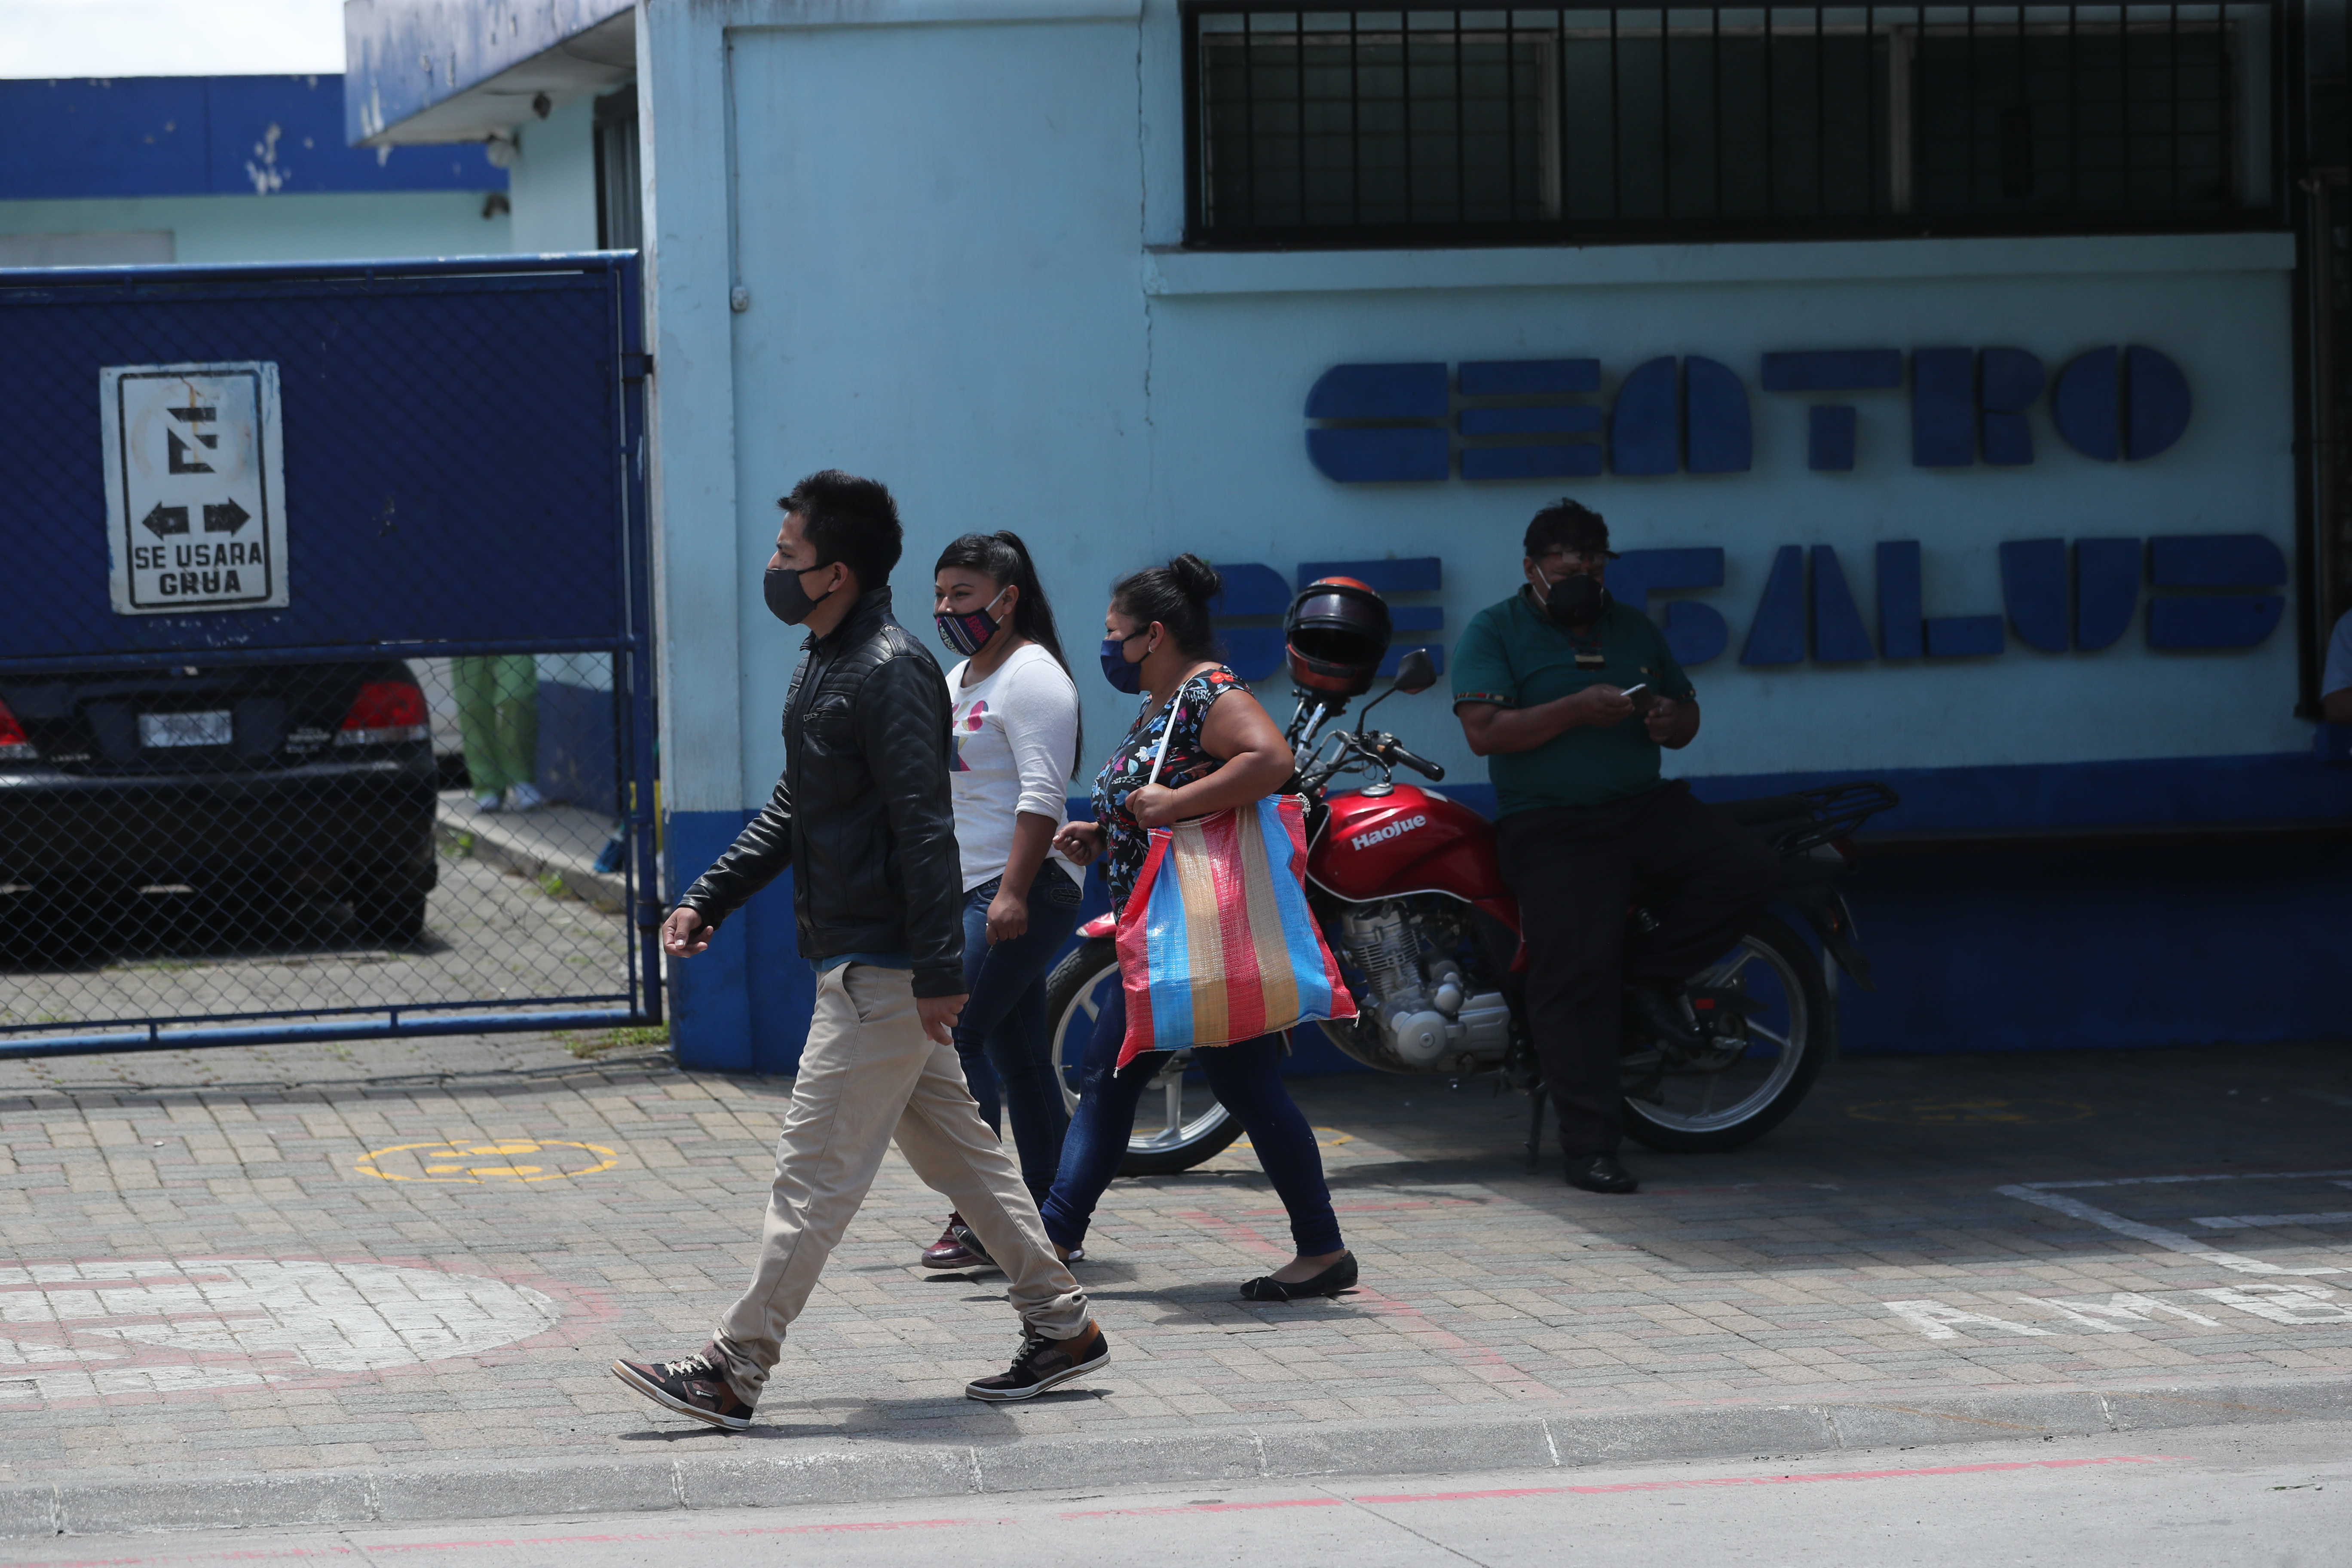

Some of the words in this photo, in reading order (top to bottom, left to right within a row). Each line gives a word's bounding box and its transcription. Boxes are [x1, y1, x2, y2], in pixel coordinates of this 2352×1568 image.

[1304, 345, 2191, 483] CENTRO
[135, 546, 167, 570] SE
[176, 542, 263, 567] USARA
[159, 570, 242, 596] GRUA
[1605, 534, 2287, 665] SALUD
